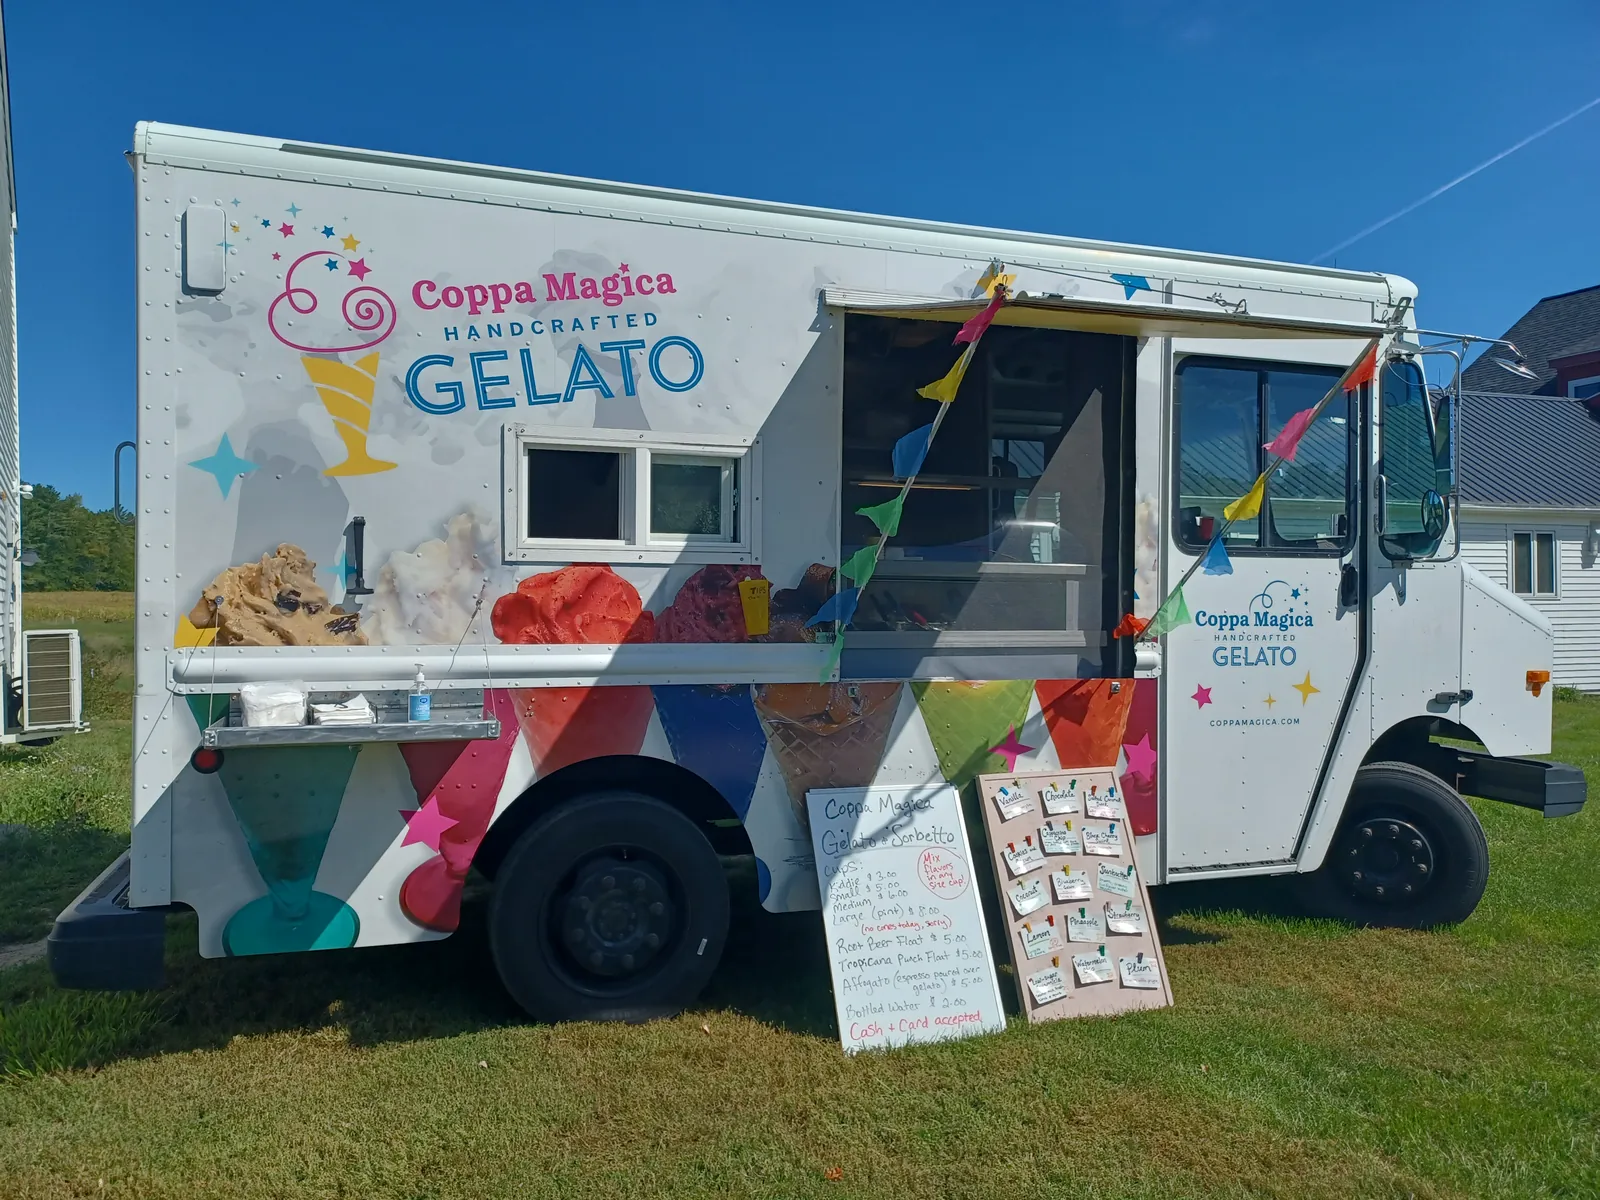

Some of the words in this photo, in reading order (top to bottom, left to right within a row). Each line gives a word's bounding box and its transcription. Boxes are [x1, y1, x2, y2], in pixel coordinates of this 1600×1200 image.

[412, 279, 537, 315] Coppa
[543, 263, 677, 307] Magica
[444, 312, 658, 342] HANDCRAFTED
[405, 335, 705, 416] GELATO
[1195, 610, 1250, 631] Coppa
[1254, 609, 1314, 632] Magica
[1214, 634, 1296, 642] HANDCRAFTED
[1212, 645, 1297, 667] GELATO
[1209, 718, 1300, 727] COPPAMAGICA.COM
[999, 792, 1024, 806] Vanilla
[1044, 790, 1076, 802] Chocolate
[825, 798, 873, 820] Coppa
[879, 793, 935, 818] Magica
[821, 828, 878, 856] Gelato
[892, 823, 955, 848] Sorbetto
[923, 852, 941, 864] Mix
[924, 862, 954, 875] flavors
[926, 873, 937, 881] in
[938, 871, 953, 880] any
[1015, 886, 1038, 903] Coconut
[872, 902, 904, 921] (pint)
[861, 923, 874, 936] (no
[1069, 916, 1099, 927] Pineapple
[836, 937, 864, 954] Root
[866, 936, 893, 952] Beer
[895, 934, 924, 946] Float
[1026, 930, 1051, 944] Lemon
[838, 958, 893, 973] Tropicana
[897, 953, 923, 967] Punch
[925, 950, 951, 963] Float
[1075, 957, 1108, 968] Watermelon
[1126, 962, 1152, 976] Plum
[842, 974, 891, 997] Affogato
[893, 969, 931, 990] (espresso
[933, 966, 960, 980] poured
[962, 966, 981, 974] over
[912, 978, 948, 997] gelato)
[845, 1002, 885, 1021] Bottled
[888, 1000, 921, 1012] Water
[850, 1021, 884, 1041] Cash
[888, 1023, 896, 1033] +
[898, 1016, 930, 1033] Card
[934, 1010, 983, 1030] accepted
